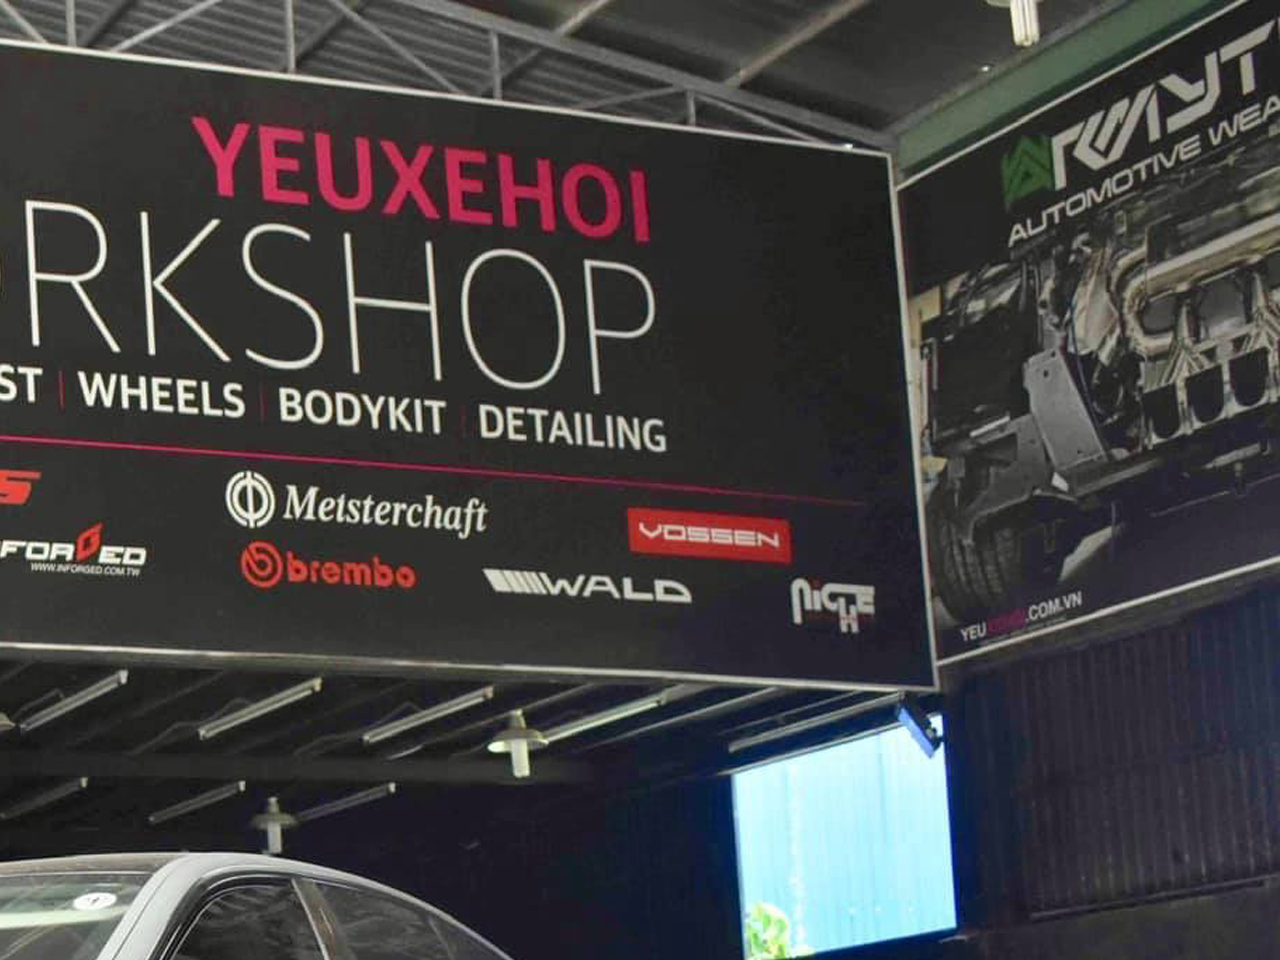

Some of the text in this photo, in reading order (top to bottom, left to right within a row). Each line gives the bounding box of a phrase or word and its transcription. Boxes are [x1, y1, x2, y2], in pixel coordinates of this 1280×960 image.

[192, 117, 651, 242] YEUXEHOI
[1008, 134, 1202, 247] AUTOMOTIVE
[77, 370, 246, 420] WHEELS
[278, 387, 447, 434] BODYKIT
[479, 404, 668, 453] DETAILING
[283, 484, 489, 539] Meisterchaft
[639, 521, 781, 548] VOSSEN
[30, 561, 141, 577] WWW.INFORGED.COM.TW
[286, 550, 417, 589] brembo
[540, 573, 693, 603] WALD
